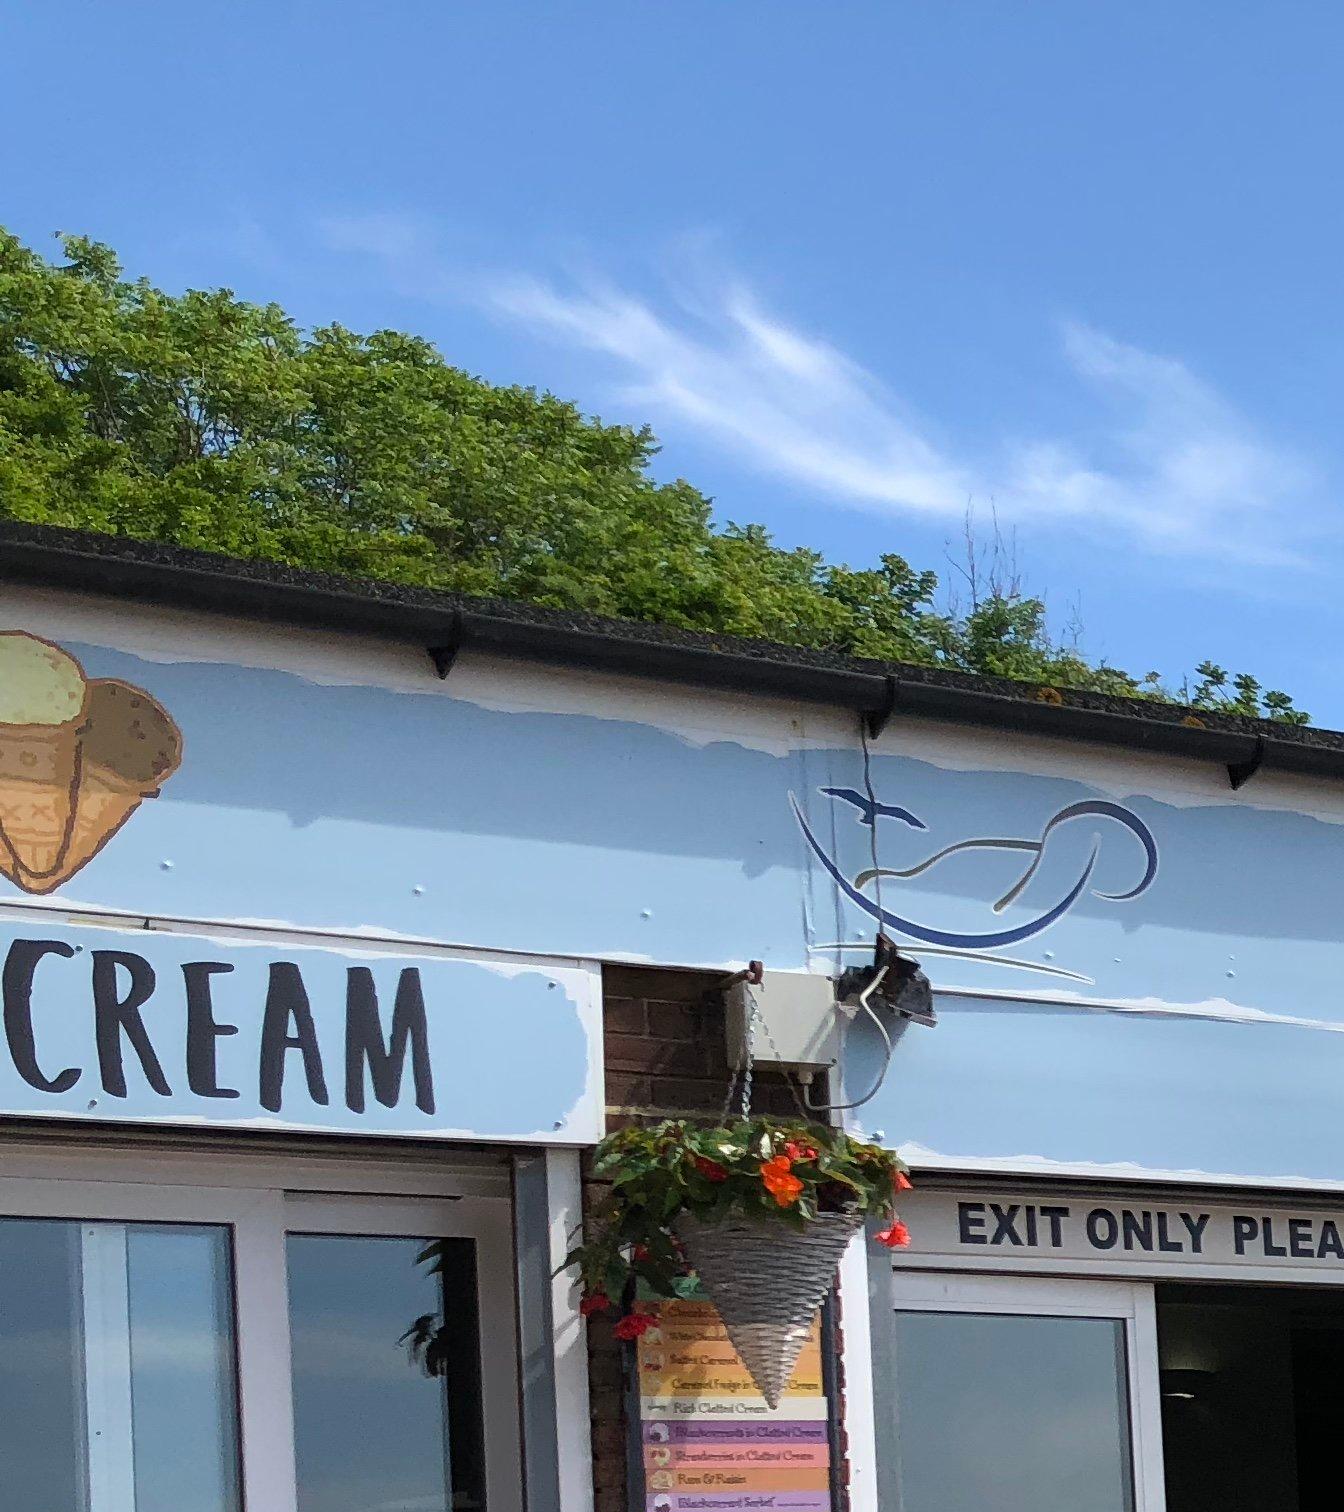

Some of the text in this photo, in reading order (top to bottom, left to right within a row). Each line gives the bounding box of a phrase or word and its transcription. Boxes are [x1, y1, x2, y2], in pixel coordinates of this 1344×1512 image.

[2, 940, 435, 1116] CREAM
[958, 1202, 1070, 1248] EXIT
[1087, 1208, 1211, 1254] ONLY
